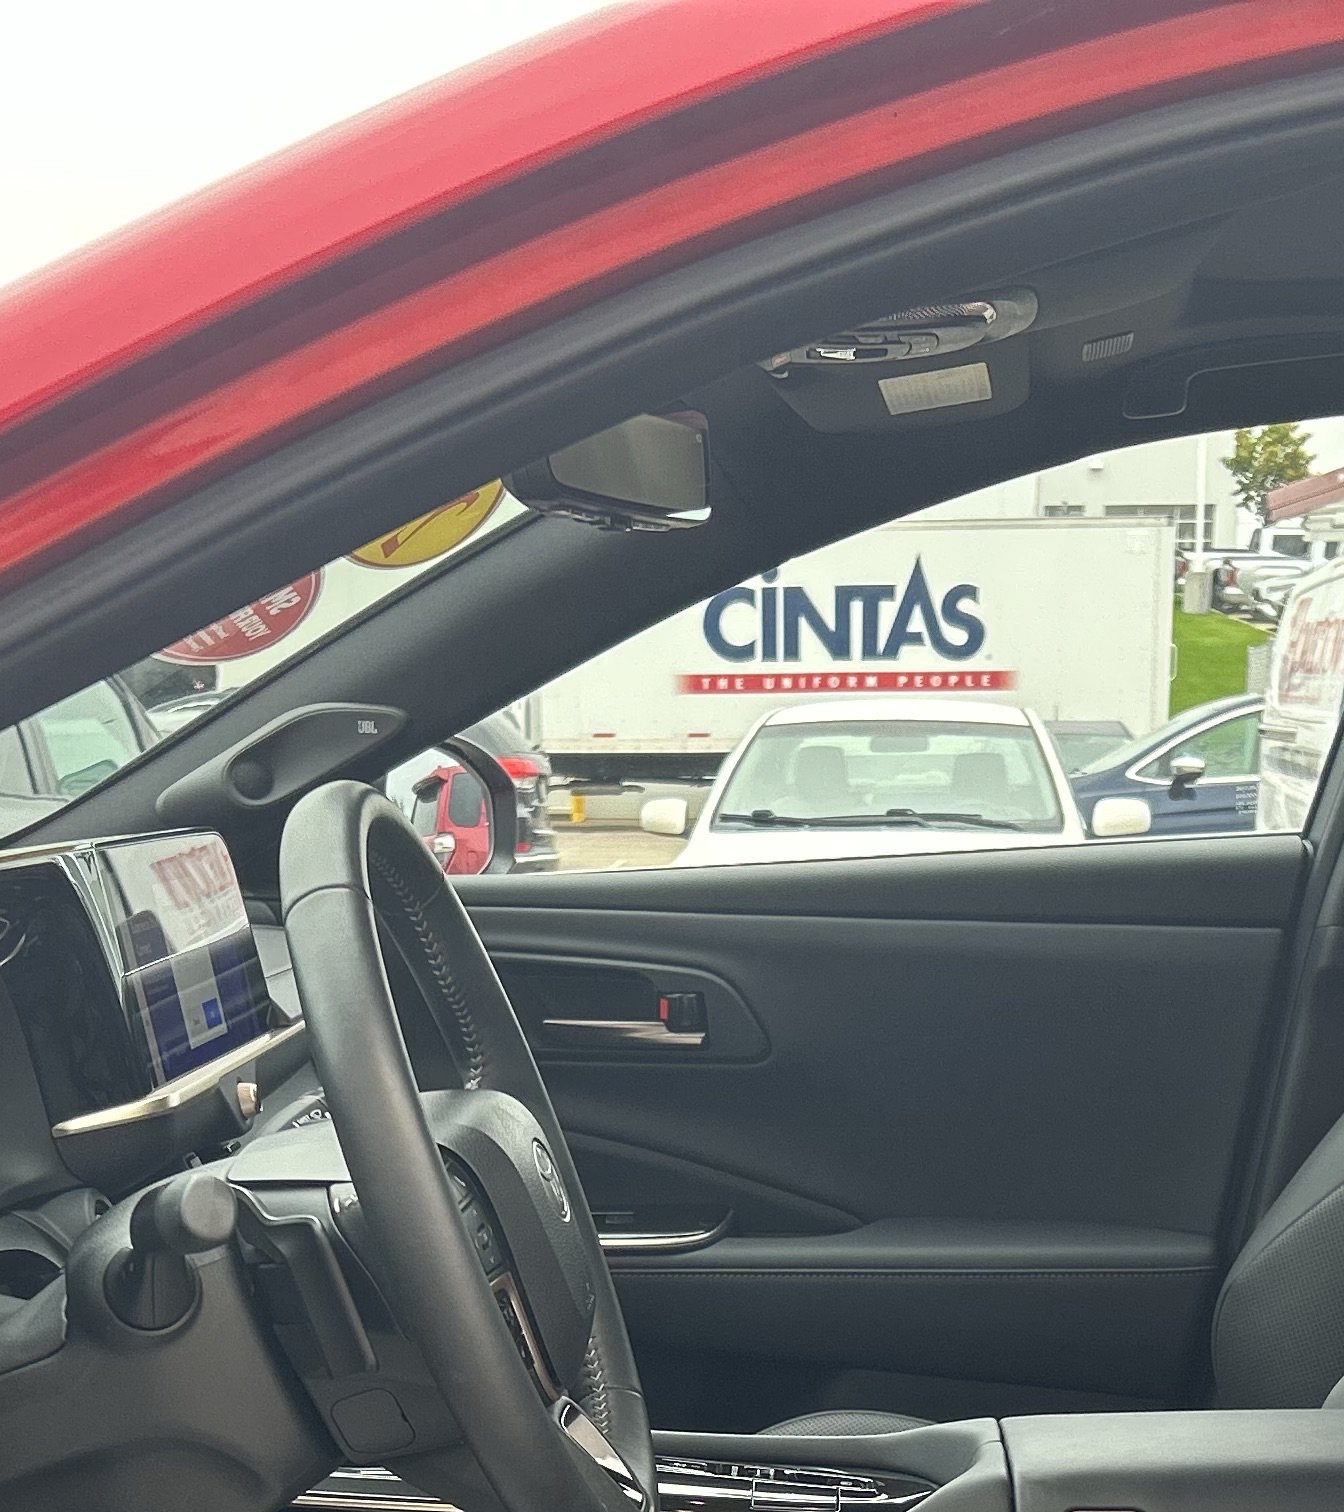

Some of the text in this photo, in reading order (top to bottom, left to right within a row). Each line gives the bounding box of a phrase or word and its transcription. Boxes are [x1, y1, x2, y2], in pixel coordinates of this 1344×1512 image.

[700, 674, 993, 690] THE UNIFORM PEOPLE
[357, 720, 378, 734] JBL
